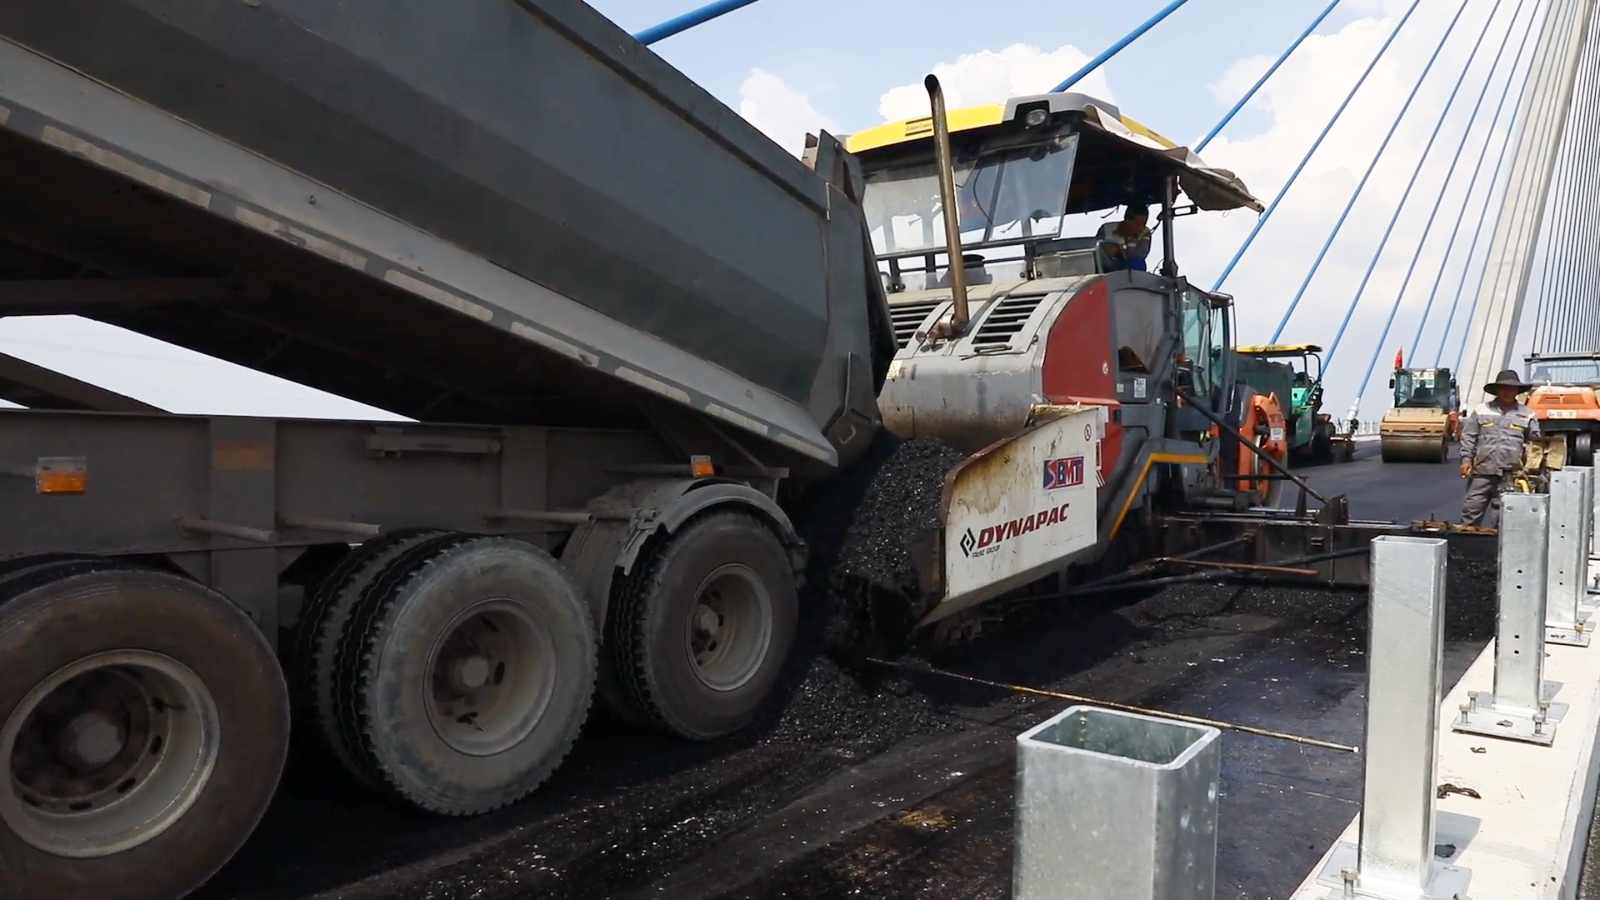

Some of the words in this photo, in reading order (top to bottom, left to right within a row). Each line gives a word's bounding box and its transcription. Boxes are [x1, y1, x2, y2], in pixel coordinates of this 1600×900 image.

[1043, 456, 1084, 490] SBMT
[977, 503, 1070, 549] DYNAPAC
[986, 544, 1001, 554] GROUP
